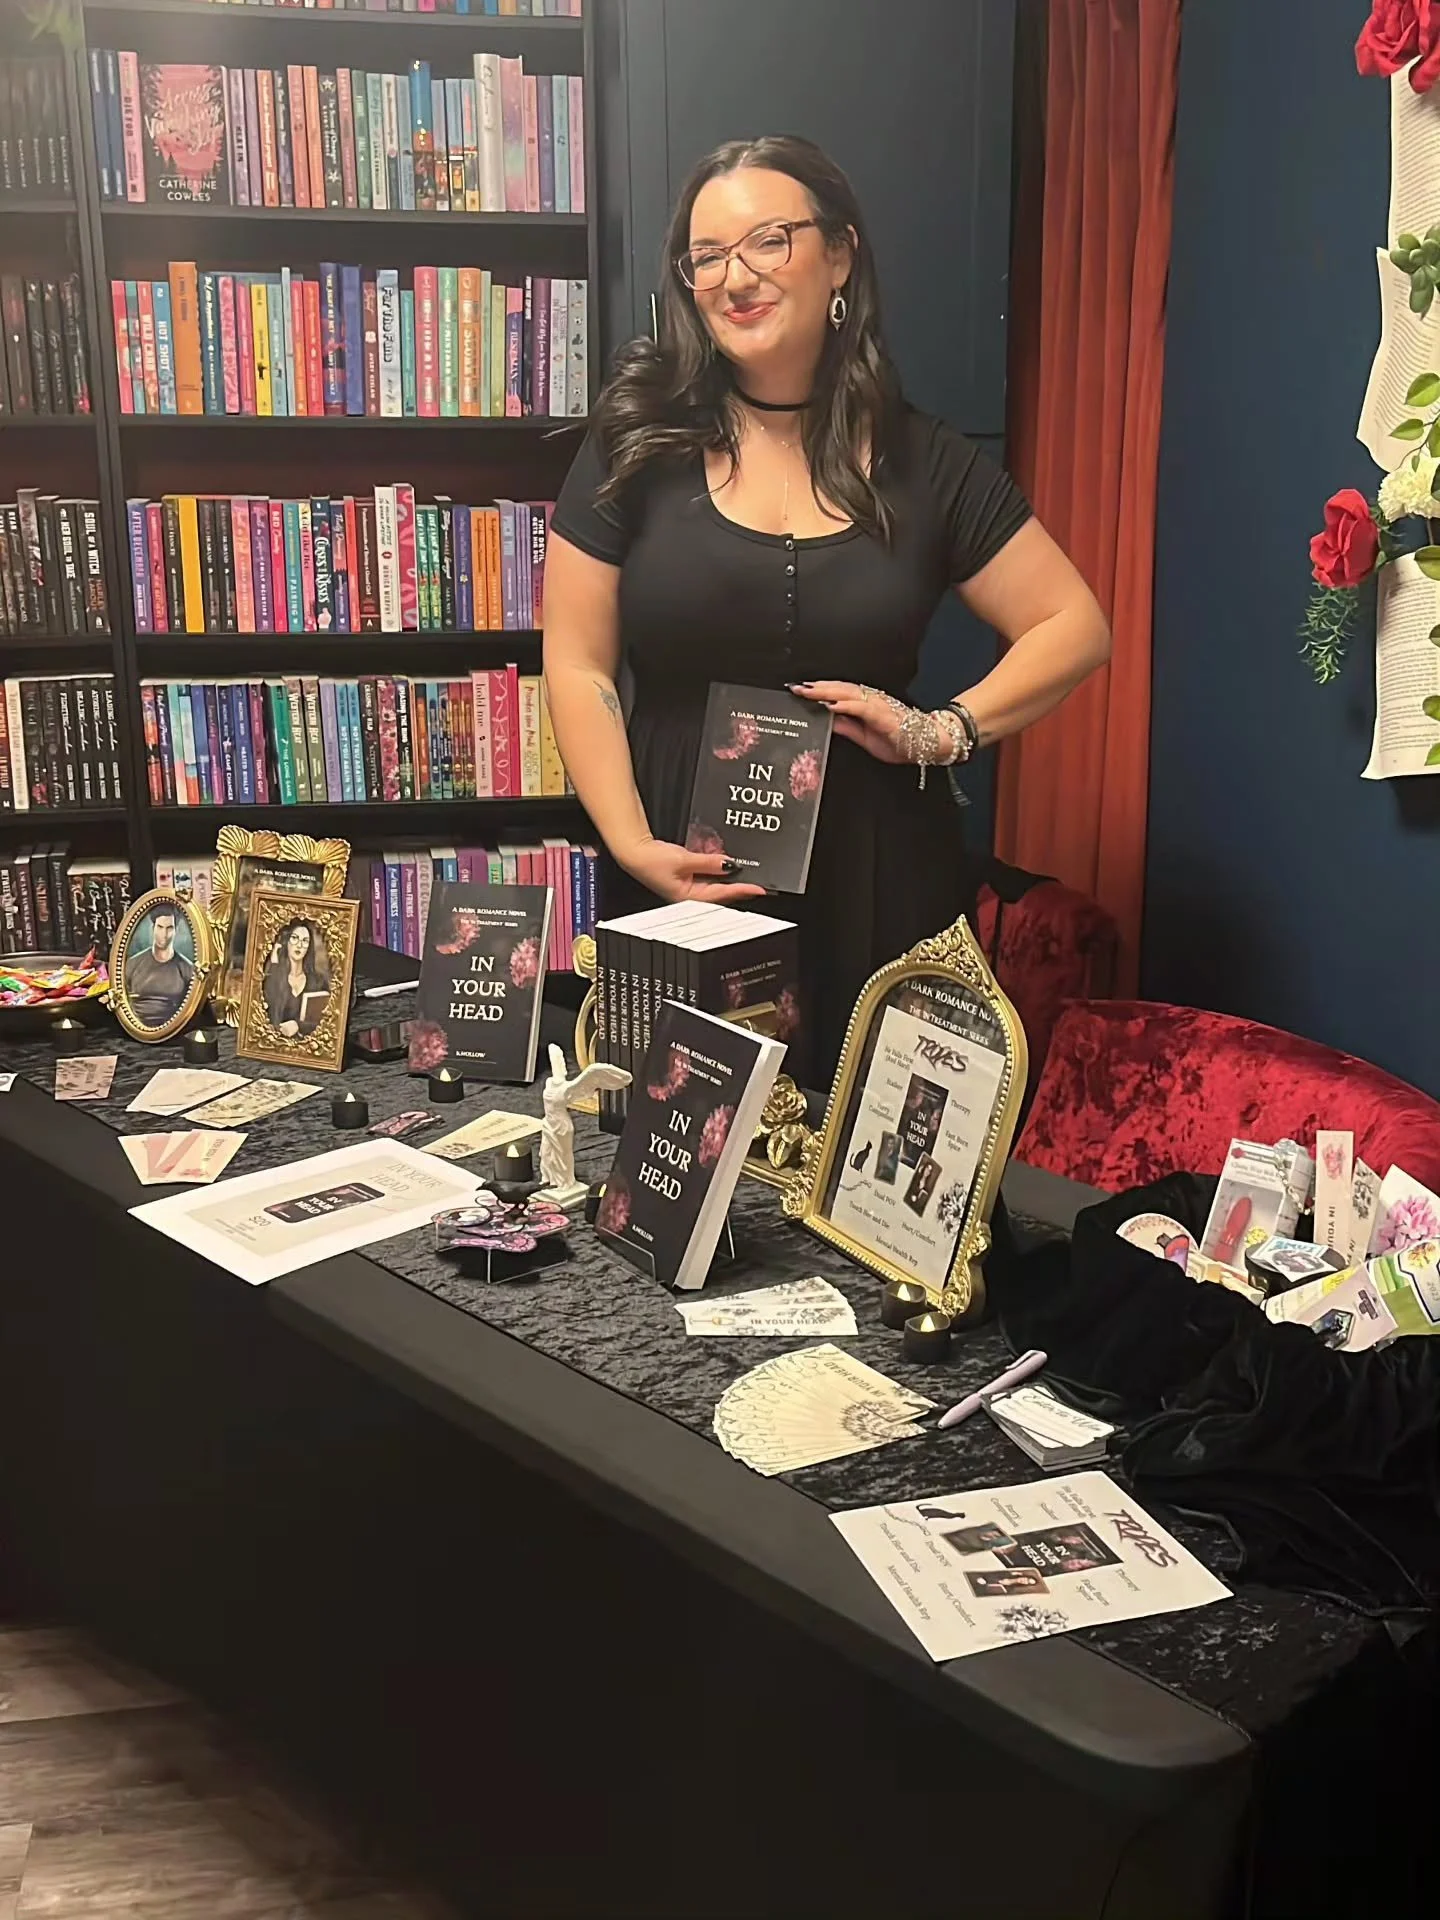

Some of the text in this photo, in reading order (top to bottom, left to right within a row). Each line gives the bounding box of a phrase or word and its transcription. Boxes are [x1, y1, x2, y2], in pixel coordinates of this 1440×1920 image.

[159, 179, 217, 190] CATHERINE
[167, 191, 211, 202] COWLES
[157, 320, 170, 370] HOT SHOT
[60, 521, 71, 535] HER
[84, 512, 96, 535] SOUL
[132, 511, 143, 536] AFTER
[88, 549, 100, 575] WITCH
[475, 683, 486, 707] hold
[737, 712, 755, 720] DARK
[756, 714, 788, 725] ROMANCE
[789, 719, 809, 728] NOVEL
[224, 754, 234, 800] GAME CHANGER
[748, 763, 773, 781] IN
[729, 784, 784, 808] YOUR
[725, 809, 781, 832] HEAD
[477, 908, 508, 916] ROMANCE
[470, 956, 495, 972] IN
[597, 966, 604, 979] IN
[609, 969, 617, 982] IN
[620, 971, 628, 985] IN
[451, 979, 506, 997] YOUR
[654, 979, 662, 992] IN
[666, 983, 674, 996] IN
[677, 986, 685, 999] IN
[620, 987, 628, 1013] YOUR
[642, 977, 650, 1018] IN YOUR
[689, 989, 696, 1002] IN
[911, 981, 933, 998] DARK
[935, 991, 978, 1016] ROMANCE
[449, 1003, 504, 1022] HEAD
[631, 974, 640, 1049] IN YOUR HEAD
[598, 1010, 606, 1040] HEAD
[909, 1005, 922, 1017] THE
[930, 1014, 967, 1036] TREATMENT
[969, 1031, 990, 1046] SERIES
[675, 1043, 690, 1055] DARK
[691, 1048, 718, 1067] ROMANCE
[717, 1061, 733, 1076] NOVEL
[668, 1109, 692, 1136] IN
[917, 1111, 927, 1121] IN
[910, 1120, 929, 1137] YOUR
[906, 1132, 926, 1148] HEAD
[648, 1133, 692, 1173] YOUR
[369, 1175, 411, 1193] HEAD
[637, 1162, 682, 1201] HEAD
[297, 1201, 321, 1214] HEAD
[309, 1196, 335, 1211] YOUR
[1329, 1206, 1335, 1218] IN
[765, 1318, 794, 1326] YOUR
[1104, 1509, 1179, 1568] TROPES
[1022, 1545, 1046, 1567] HEAD
[1036, 1541, 1061, 1565] YOUR
[1055, 1545, 1070, 1557] IN
